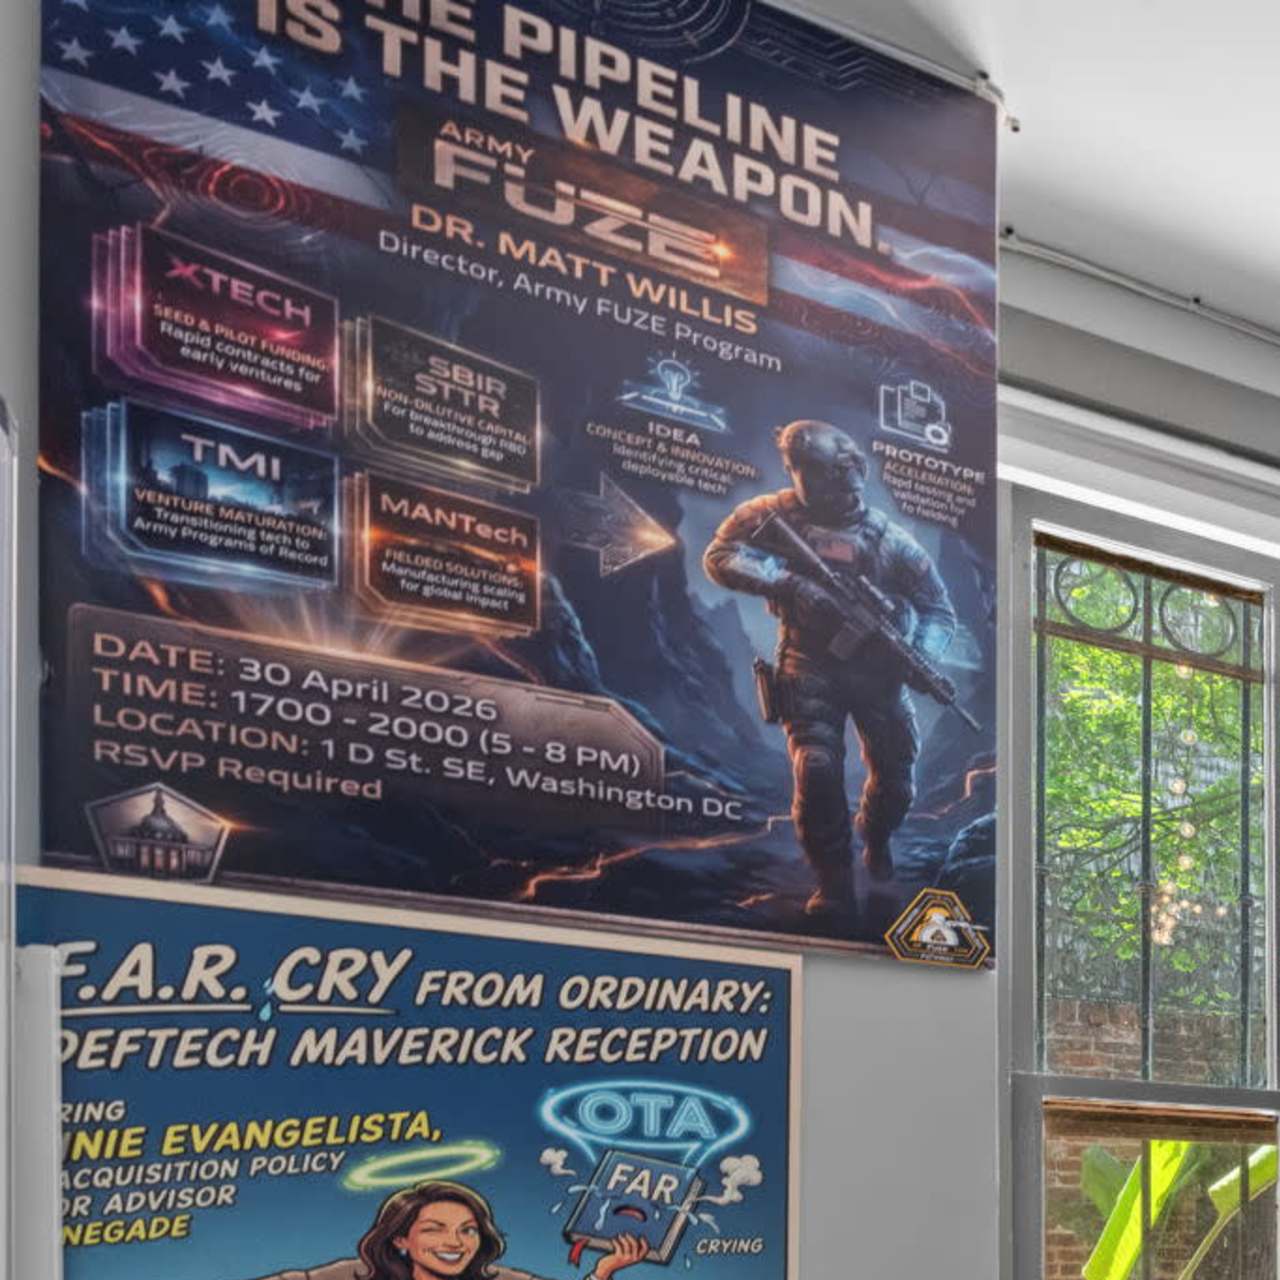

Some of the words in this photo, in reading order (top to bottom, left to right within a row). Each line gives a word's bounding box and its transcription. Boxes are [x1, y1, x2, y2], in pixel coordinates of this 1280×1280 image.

[504, 4, 840, 182] PIPELINE
[257, 0, 342, 53] IS
[365, 14, 530, 124] THE
[552, 84, 889, 252] WEAPON.
[439, 119, 535, 165] ARMY
[434, 138, 721, 278] FUZE
[411, 203, 485, 249] DR.
[499, 231, 618, 288] MATT
[625, 272, 759, 335] WILLIS
[378, 229, 503, 289] Director,
[513, 272, 588, 314] Army
[597, 298, 667, 337] FUZE
[674, 323, 783, 373] Program
[153, 303, 195, 326] SEED
[198, 319, 211, 332] &
[214, 322, 257, 348] PILOT
[160, 320, 212, 350] Rapid
[215, 340, 295, 376] contracts
[299, 366, 322, 384] for
[179, 347, 226, 371] early
[230, 361, 304, 393] ventures
[415, 372, 502, 419] STTR
[428, 355, 507, 400] SBIR
[181, 433, 282, 481] TMI
[647, 420, 701, 446] IDEA
[872, 439, 986, 485] PROTOTYPE
[133, 487, 215, 517] VENTURE
[219, 505, 328, 541] MATURATION:
[155, 506, 257, 542] Transitioning
[260, 527, 293, 546] tech
[295, 535, 311, 550] to
[380, 493, 529, 548] MANTech
[133, 515, 177, 539] Army
[181, 524, 256, 554] Programs
[259, 541, 276, 557] of
[278, 545, 329, 568] Record
[92, 631, 224, 676] DATE:
[239, 657, 291, 687] 30
[302, 669, 389, 703] April
[399, 684, 499, 721] 2026
[92, 667, 218, 710] TIME:
[230, 690, 331, 727] 1700
[367, 712, 468, 750] 2000
[479, 728, 512, 757] (5
[545, 741, 567, 765] 8
[576, 745, 640, 778] PM)
[92, 704, 309, 758] LOCATION:
[319, 739, 334, 759] 1
[348, 742, 375, 764] D
[385, 747, 431, 775] St.
[442, 756, 497, 787] SE,
[505, 765, 694, 814] Washington
[701, 797, 743, 822] DC
[93, 740, 206, 774] RSVP
[217, 756, 384, 801] Required
[56, 940, 247, 1002] F.A.R.
[272, 946, 413, 1004] CRY
[415, 969, 544, 1008] FROM
[559, 974, 773, 1014] ORDINARY:
[60, 1027, 276, 1069] DEFTECH
[289, 1026, 534, 1067] MAVERICK
[544, 1027, 768, 1063] RECEPTION
[161, 1110, 443, 1159] EVANGELISTA,
[578, 1091, 718, 1139] OTA
[61, 1157, 240, 1191] ACQUISITION
[250, 1151, 345, 1178] POLICY
[606, 1162, 680, 1205] FAR
[104, 1184, 237, 1216] ADVISOR
[696, 1237, 764, 1255] CRYING
